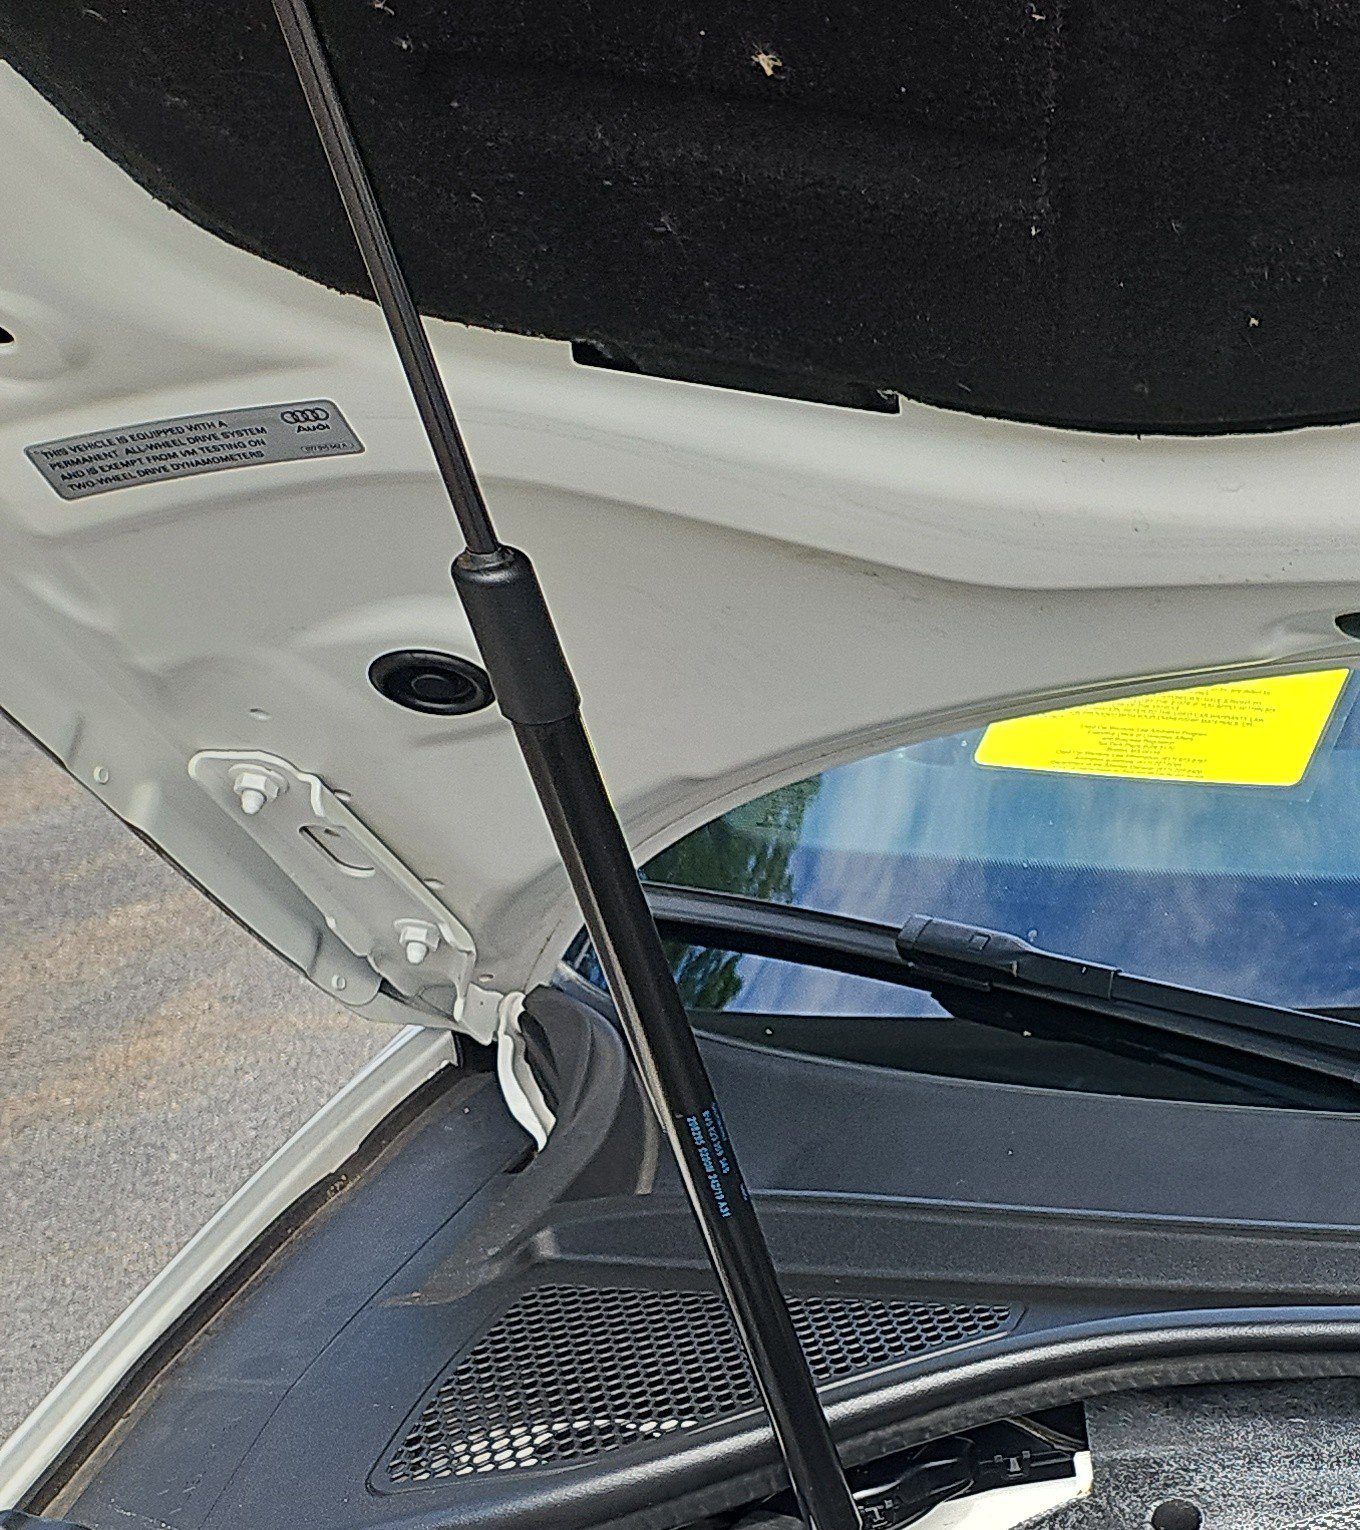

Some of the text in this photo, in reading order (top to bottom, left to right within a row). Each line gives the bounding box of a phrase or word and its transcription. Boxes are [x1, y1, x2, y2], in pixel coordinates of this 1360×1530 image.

[48, 449, 119, 471] PERMANENT
[186, 429, 220, 446] DRIVE
[220, 425, 268, 440] SYSTEM
[68, 438, 115, 455] VEHICLE
[128, 425, 185, 443] EQUIPPED
[98, 456, 144, 474] EXEMPT
[145, 451, 180, 464] FROM
[200, 439, 248, 453] TESTING
[247, 437, 266, 448] ON
[136, 465, 171, 478] DRIVE
[169, 450, 265, 471] DYNAMOMETERS
